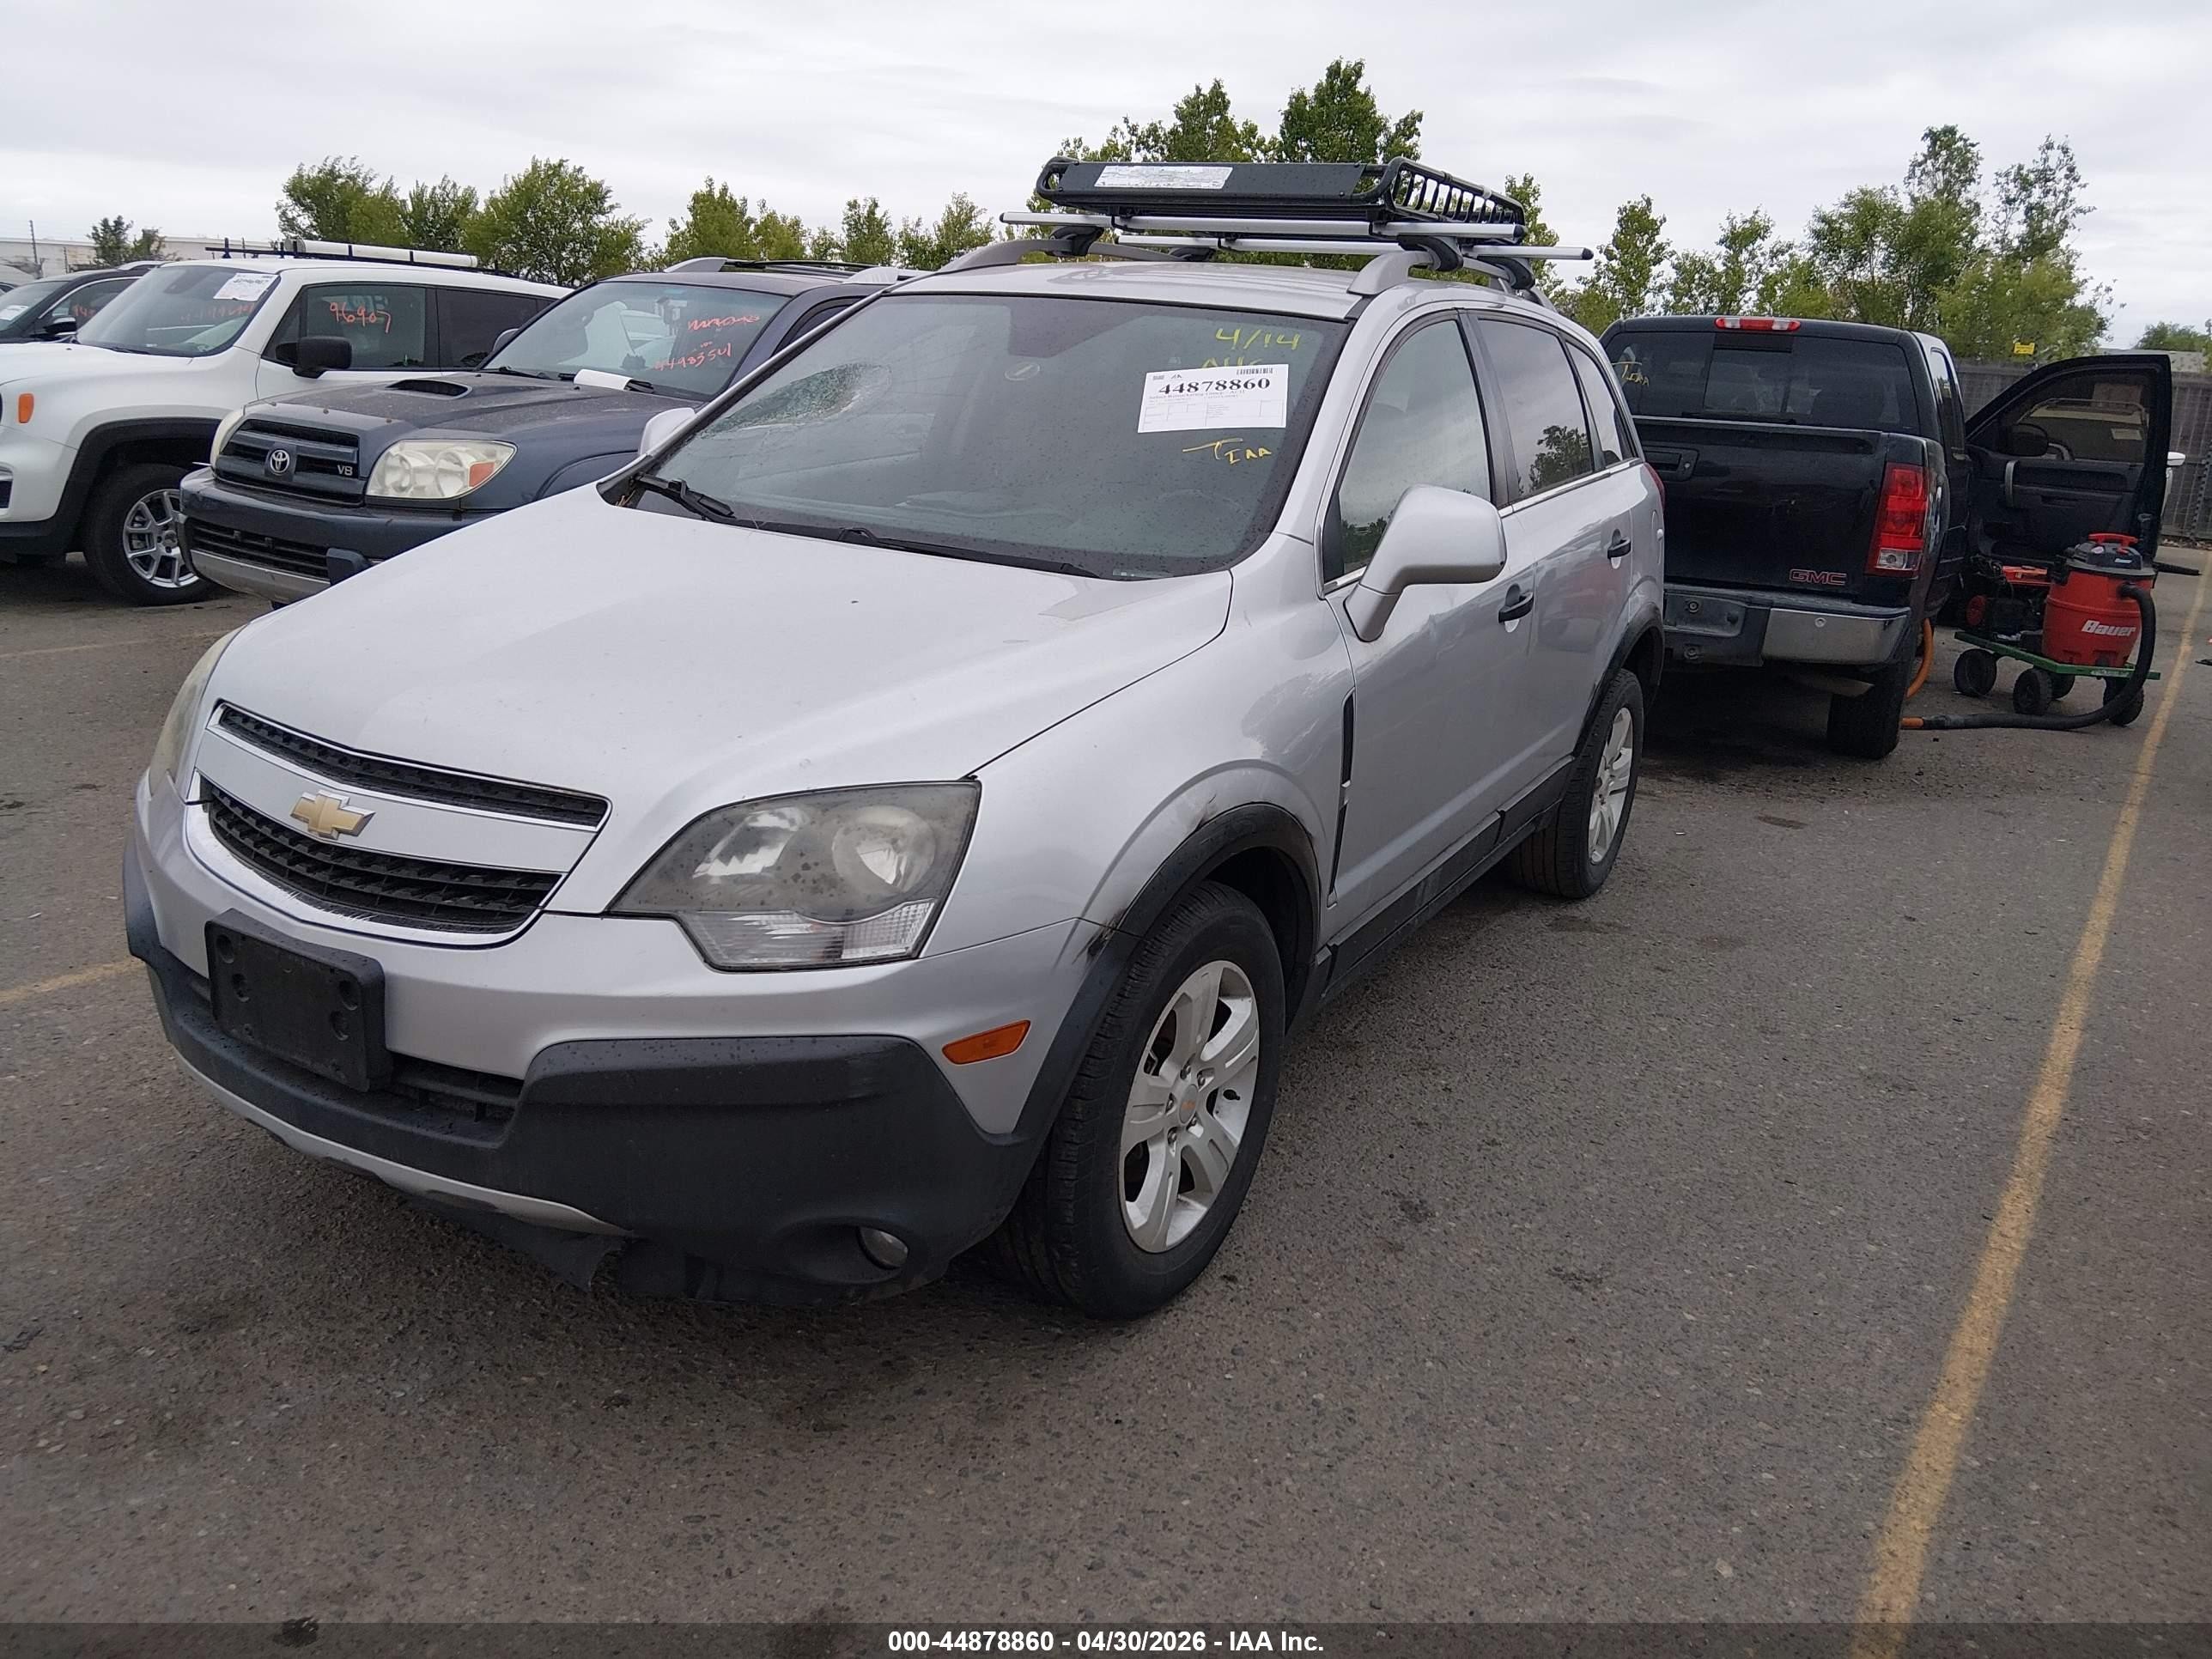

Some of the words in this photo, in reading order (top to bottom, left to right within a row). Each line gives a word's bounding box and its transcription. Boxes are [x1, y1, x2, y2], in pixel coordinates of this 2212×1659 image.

[330, 301, 392, 334] 96907
[1215, 328, 1301, 350] 4/14
[1158, 377, 1271, 395] 44878860
[337, 464, 353, 476] V8
[1789, 568, 1847, 586] GMC
[2081, 619, 2137, 637] Bauer
